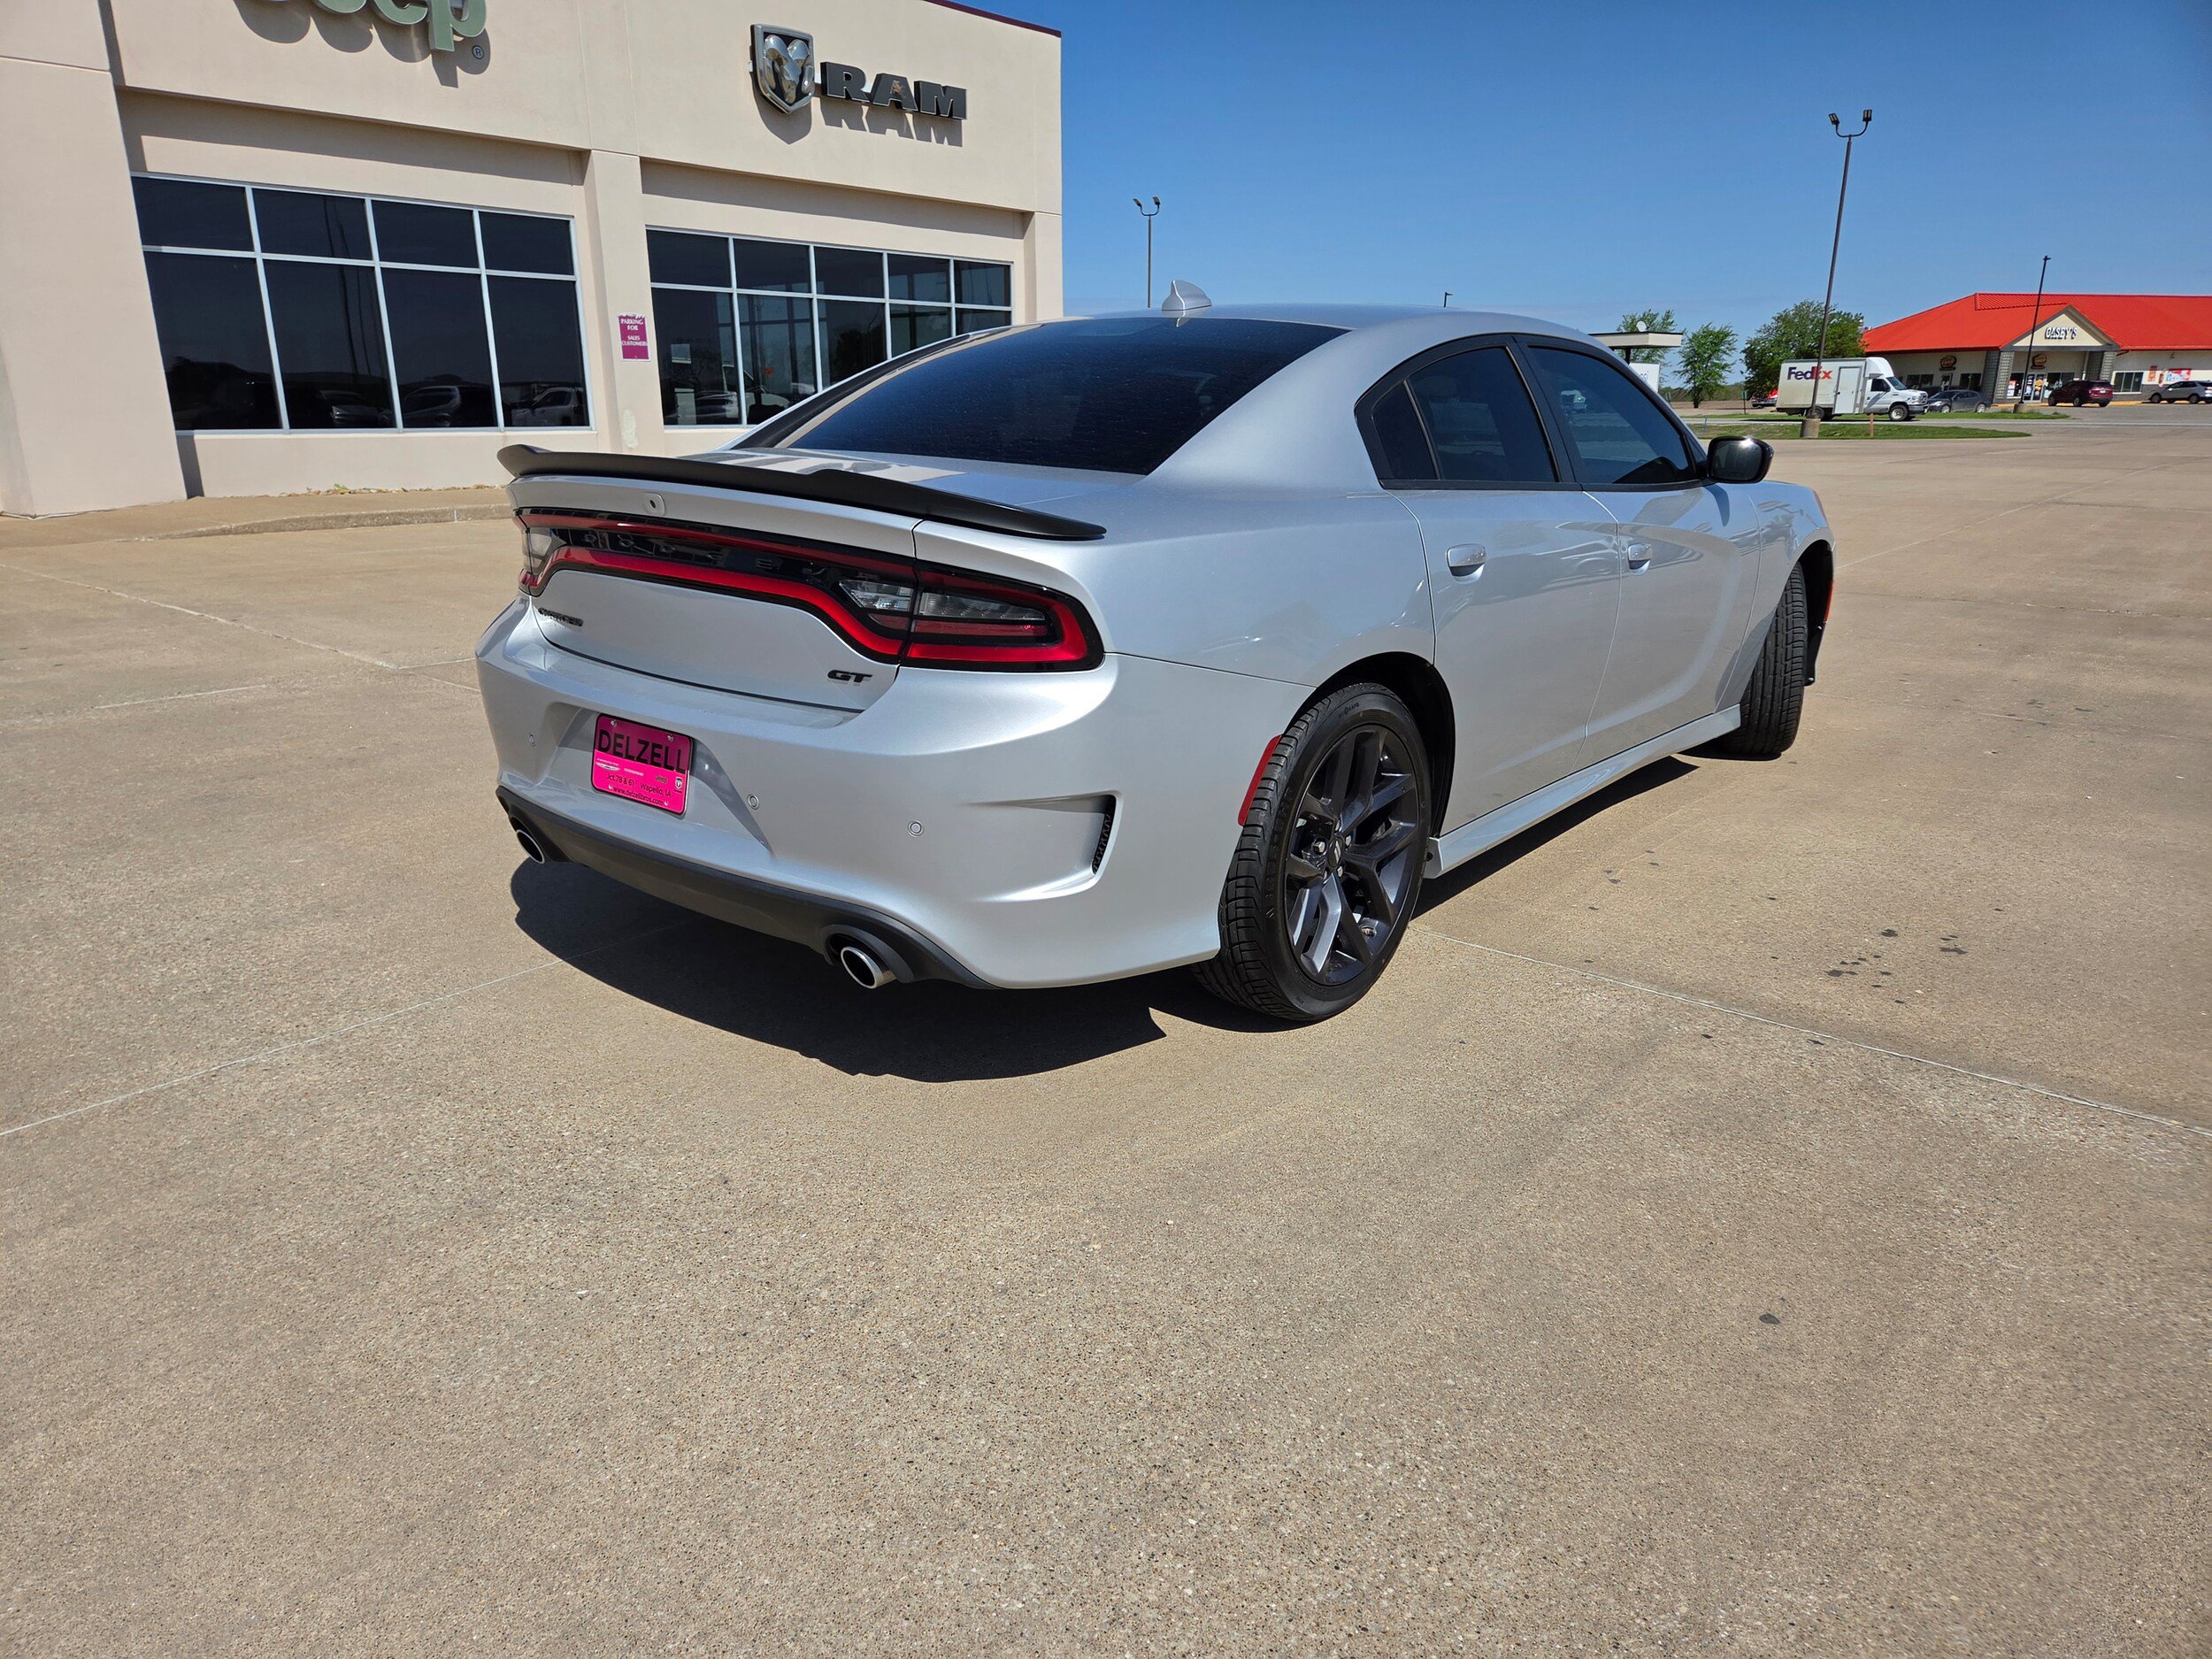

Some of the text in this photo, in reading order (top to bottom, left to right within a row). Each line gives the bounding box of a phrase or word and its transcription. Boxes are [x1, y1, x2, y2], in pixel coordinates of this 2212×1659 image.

[820, 61, 966, 119] RAM
[2045, 326, 2078, 340] CASEY'S
[827, 670, 873, 684] GT
[597, 729, 687, 774] DELZELL
